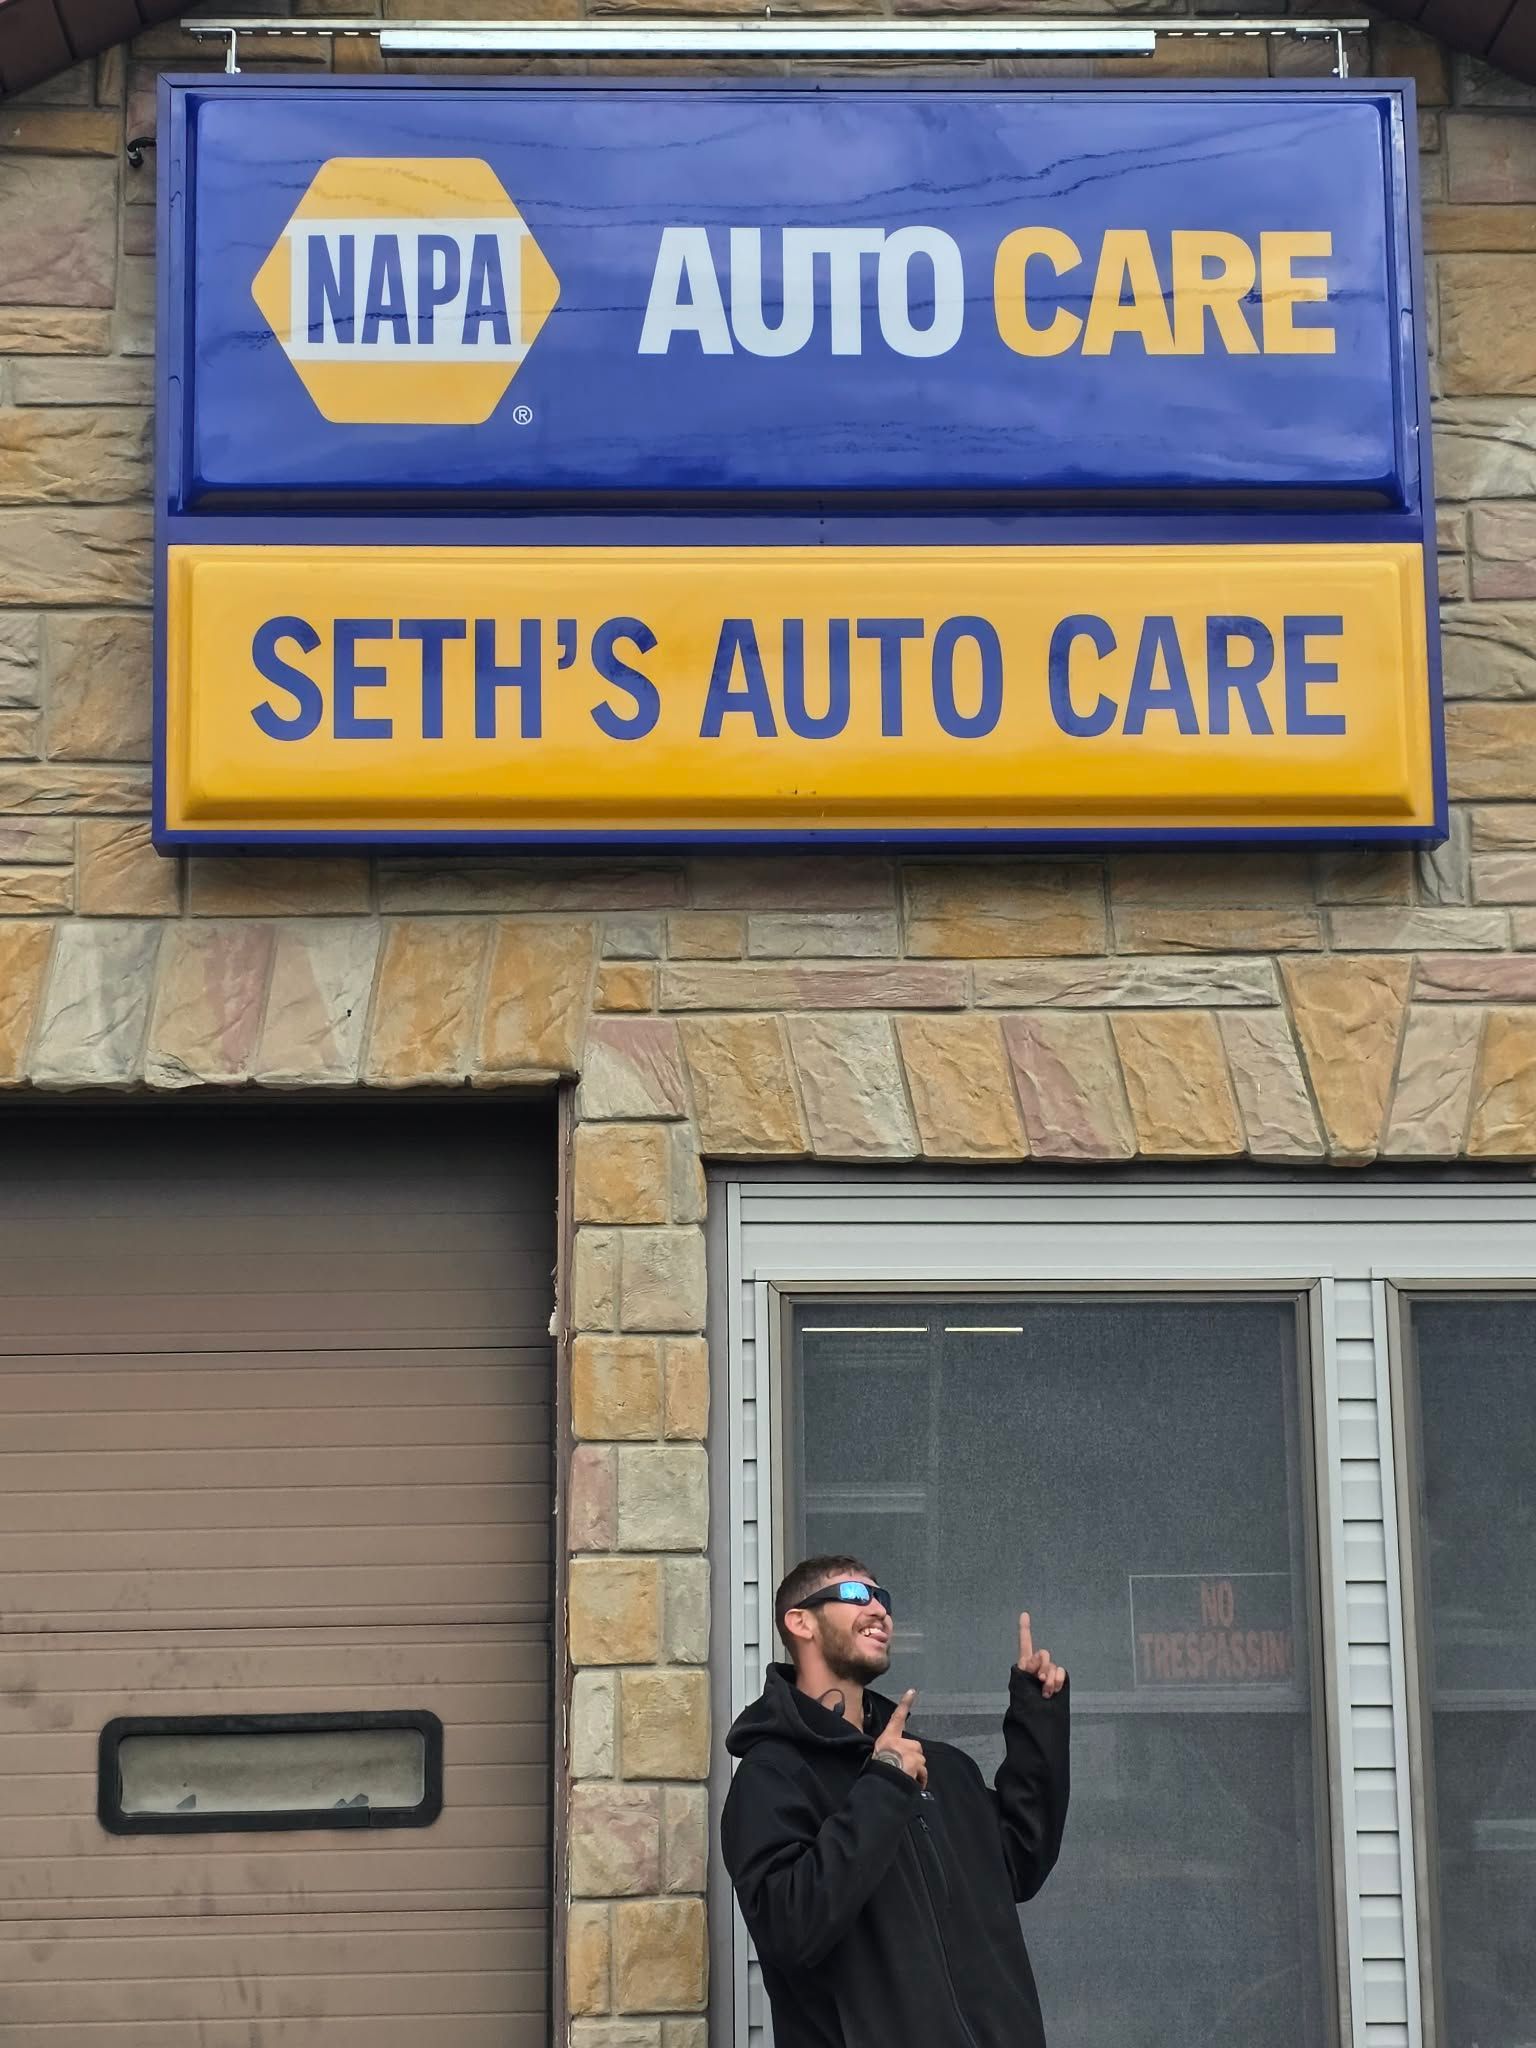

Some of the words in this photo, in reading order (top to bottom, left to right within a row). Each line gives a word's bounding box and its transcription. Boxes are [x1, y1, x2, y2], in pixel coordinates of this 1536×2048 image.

[307, 234, 512, 345] NAPA
[637, 226, 965, 358] AUTO
[994, 226, 1336, 358] CARE
[250, 616, 661, 741] SETH'S
[699, 615, 1003, 740] AUTO
[1048, 614, 1346, 738] CARE
[1201, 1580, 1234, 1628] NO
